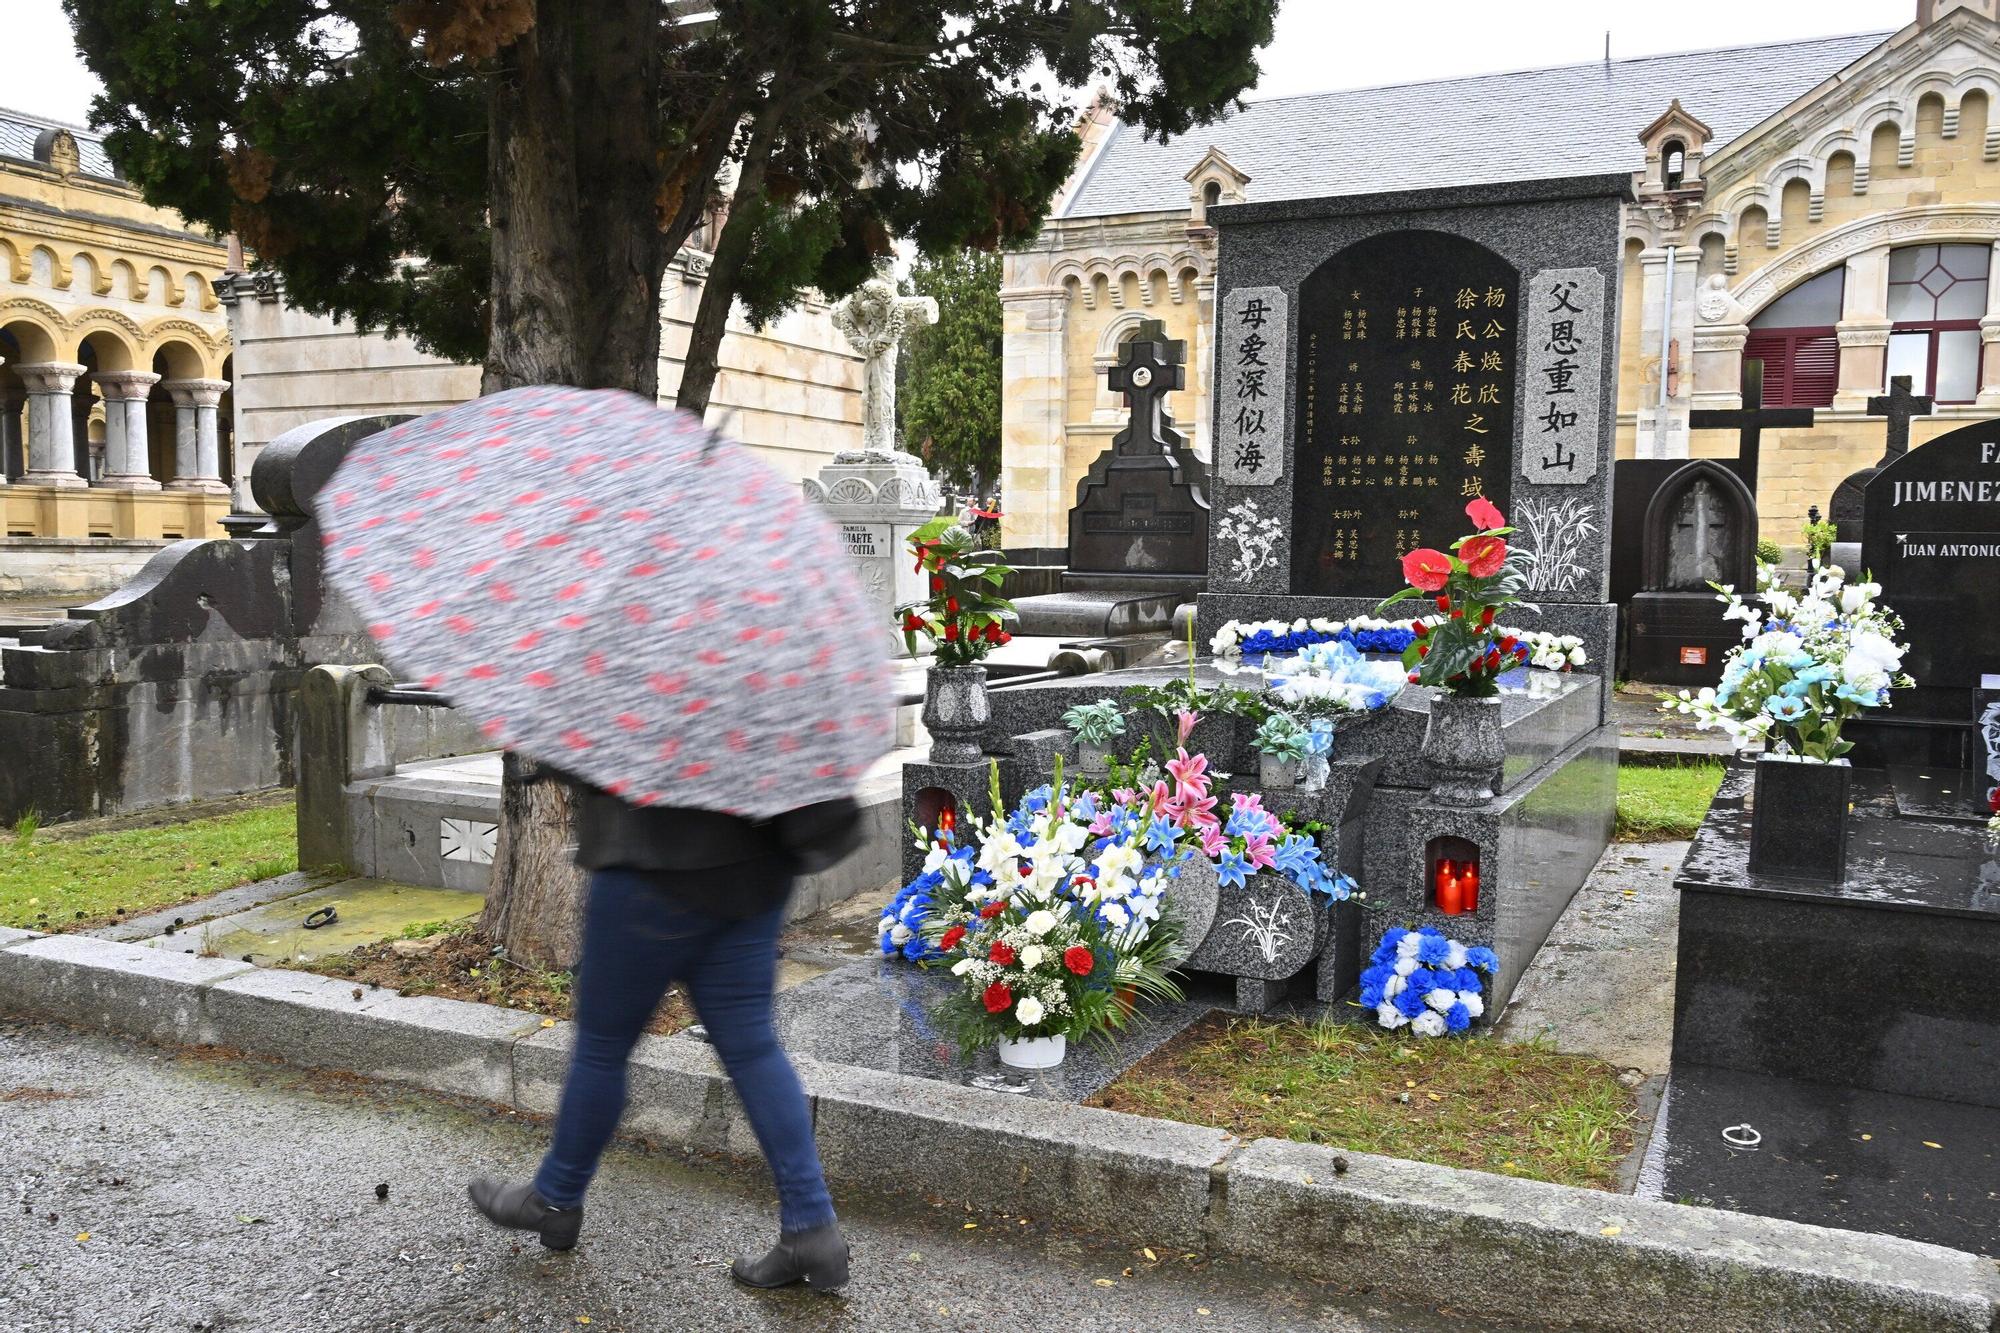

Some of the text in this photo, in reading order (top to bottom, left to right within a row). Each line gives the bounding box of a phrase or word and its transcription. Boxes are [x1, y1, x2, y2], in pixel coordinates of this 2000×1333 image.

[1352, 290, 1361, 300] 女
[1414, 287, 1424, 298] 子
[1396, 307, 1407, 339] 杨忠泽
[1450, 288, 1478, 406] 徐氏春花
[1477, 286, 1506, 406] 杨公焕欣
[1234, 299, 1272, 473] 母爱深似海
[1541, 281, 1583, 472] 父恩重如山
[1394, 381, 1404, 414] 邱晓霞
[1408, 382, 1419, 413] 王咏梅
[1407, 435, 1418, 445] 孙
[1352, 455, 1361, 486] 杨心如
[1462, 414, 1489, 499] 之壽域
[1903, 544, 1936, 558] JUAN
